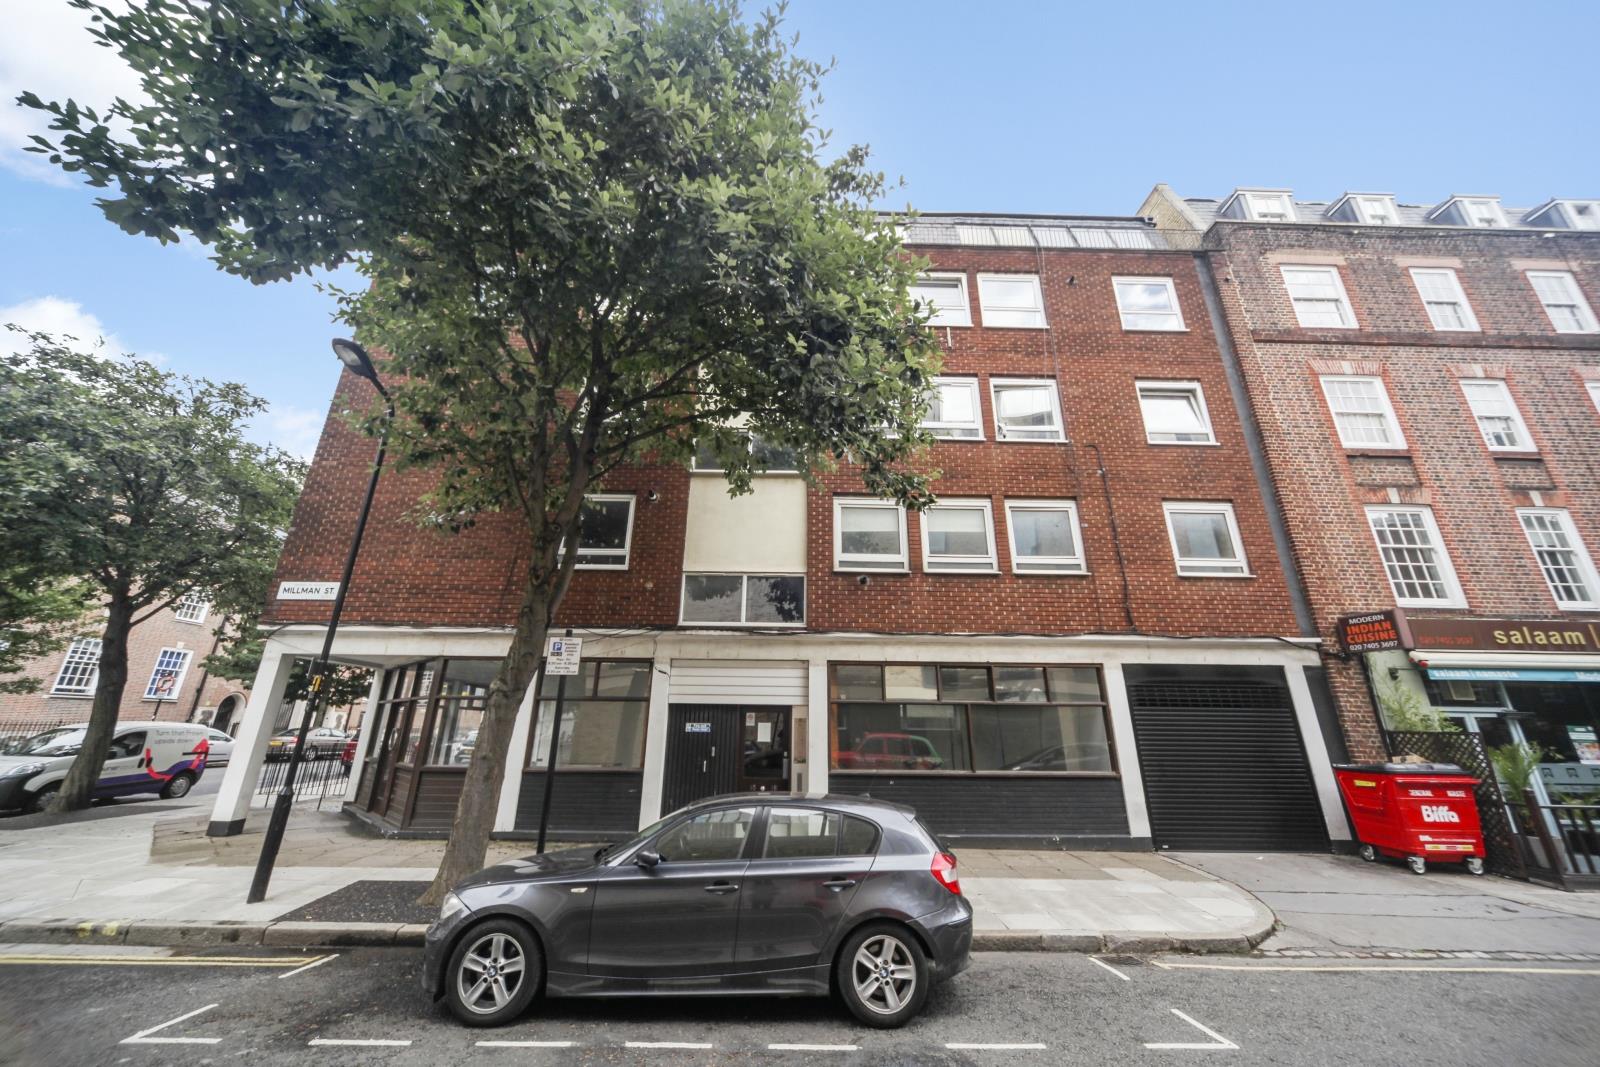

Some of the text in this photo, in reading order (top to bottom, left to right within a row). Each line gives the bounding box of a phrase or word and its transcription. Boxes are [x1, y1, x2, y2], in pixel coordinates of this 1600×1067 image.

[1348, 614, 1385, 624] MODERN
[1346, 620, 1393, 635] INDIAN
[1346, 629, 1398, 644] CUISINE
[1493, 626, 1587, 645] salaam
[1421, 805, 1460, 822] Biffa
